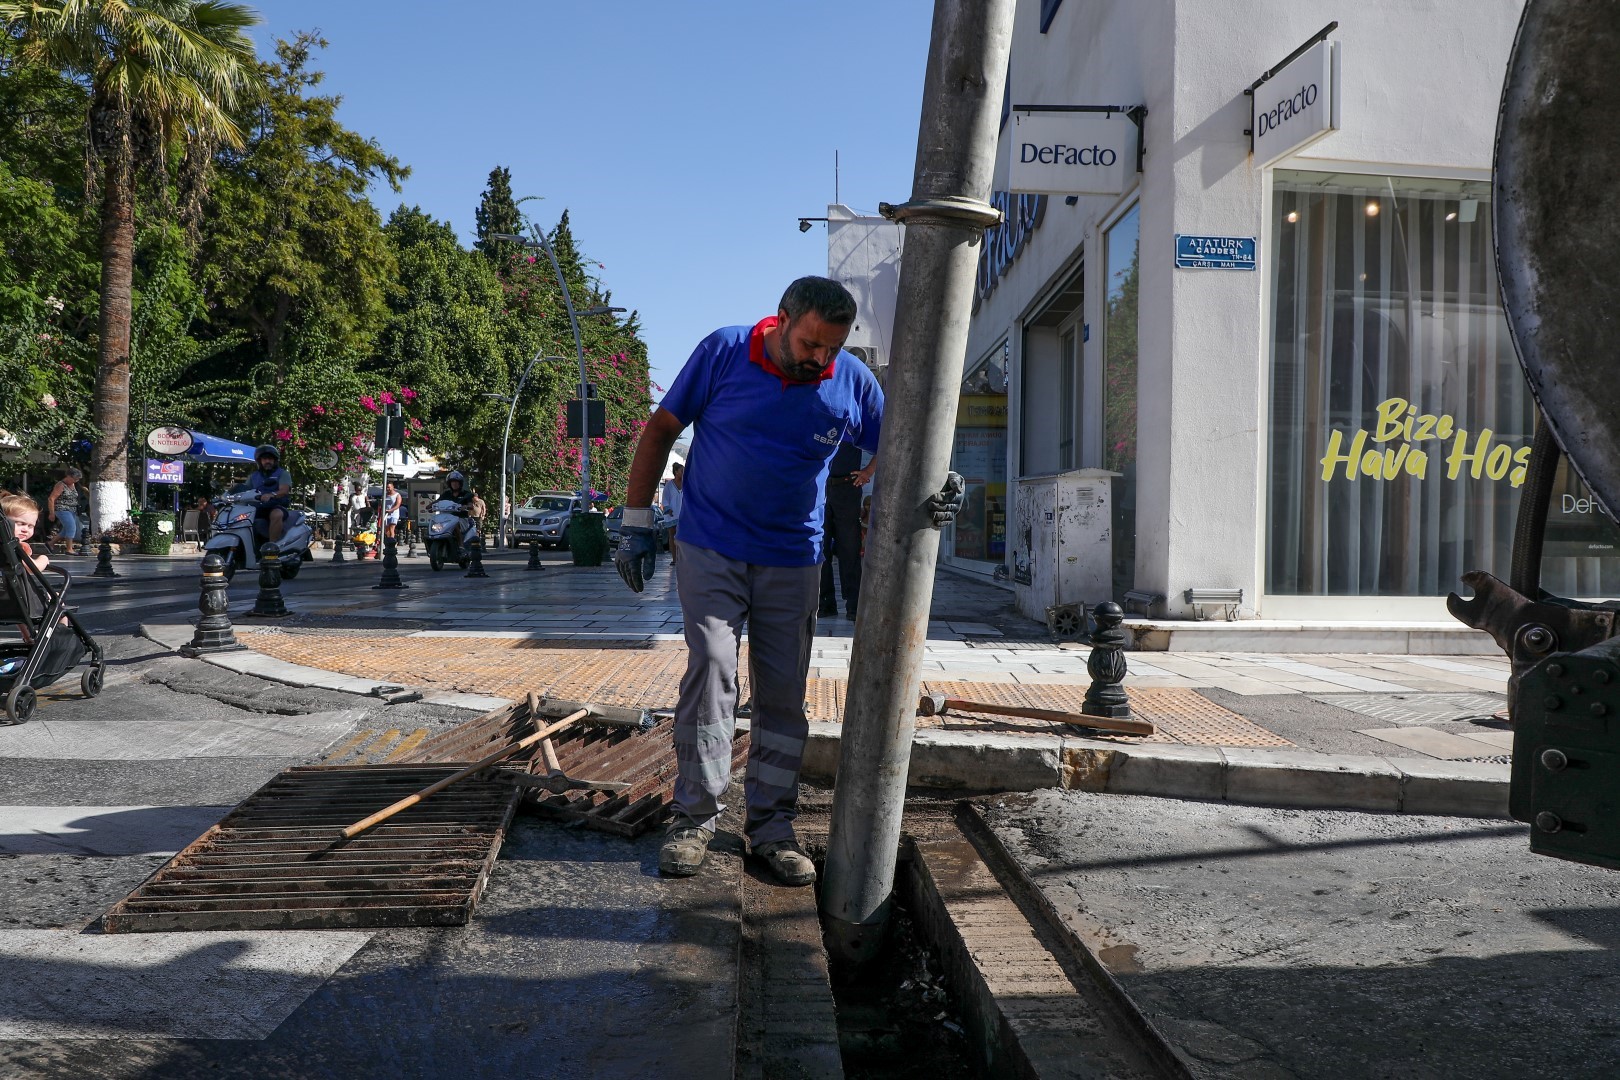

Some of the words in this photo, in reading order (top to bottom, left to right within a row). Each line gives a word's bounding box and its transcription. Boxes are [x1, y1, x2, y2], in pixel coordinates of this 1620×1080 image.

[1258, 83, 1318, 138] DeFacto
[1020, 143, 1117, 166] DeFacto
[1371, 397, 1454, 443] Bize
[1319, 428, 1429, 482] Hava
